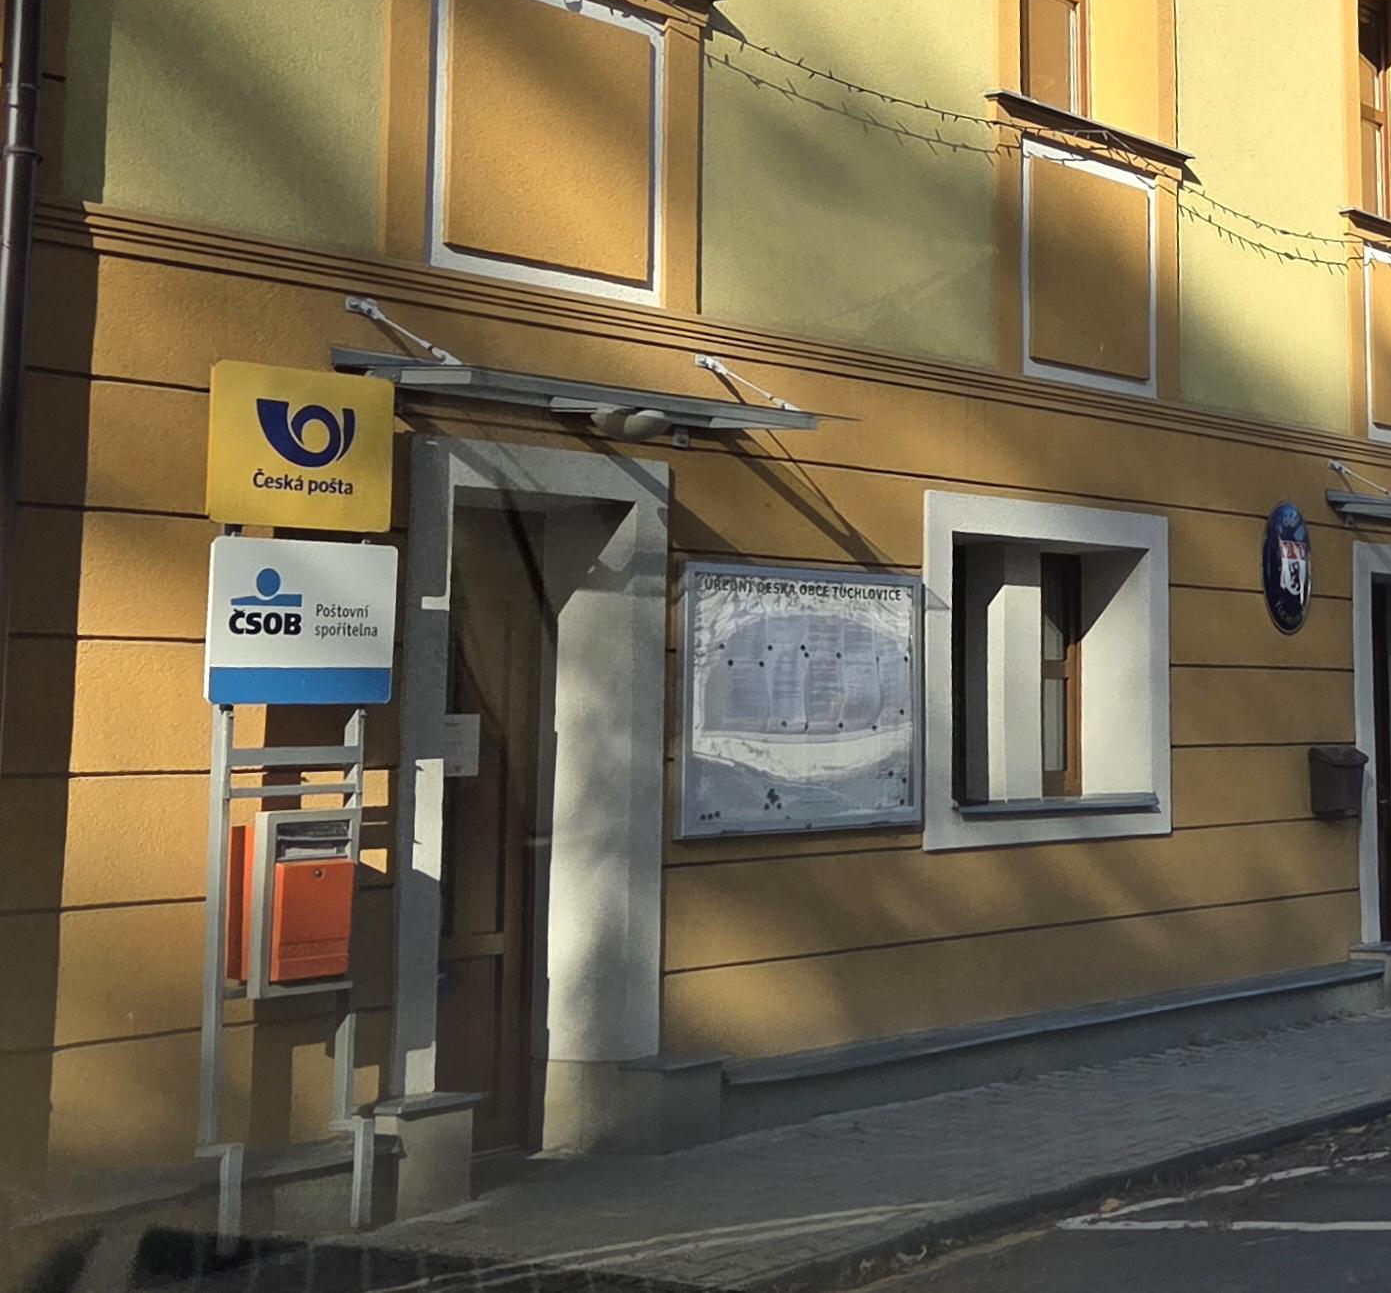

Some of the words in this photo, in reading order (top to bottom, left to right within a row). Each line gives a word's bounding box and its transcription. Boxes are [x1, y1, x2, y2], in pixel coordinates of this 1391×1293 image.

[253, 468, 303, 492] Česká
[308, 474, 354, 495] pošta
[799, 583, 829, 597] OBCE
[831, 586, 902, 602] TUCHLOVICE
[316, 604, 369, 619] Poštovní
[229, 608, 303, 636] ČSOB
[315, 622, 378, 638] spořitelna
